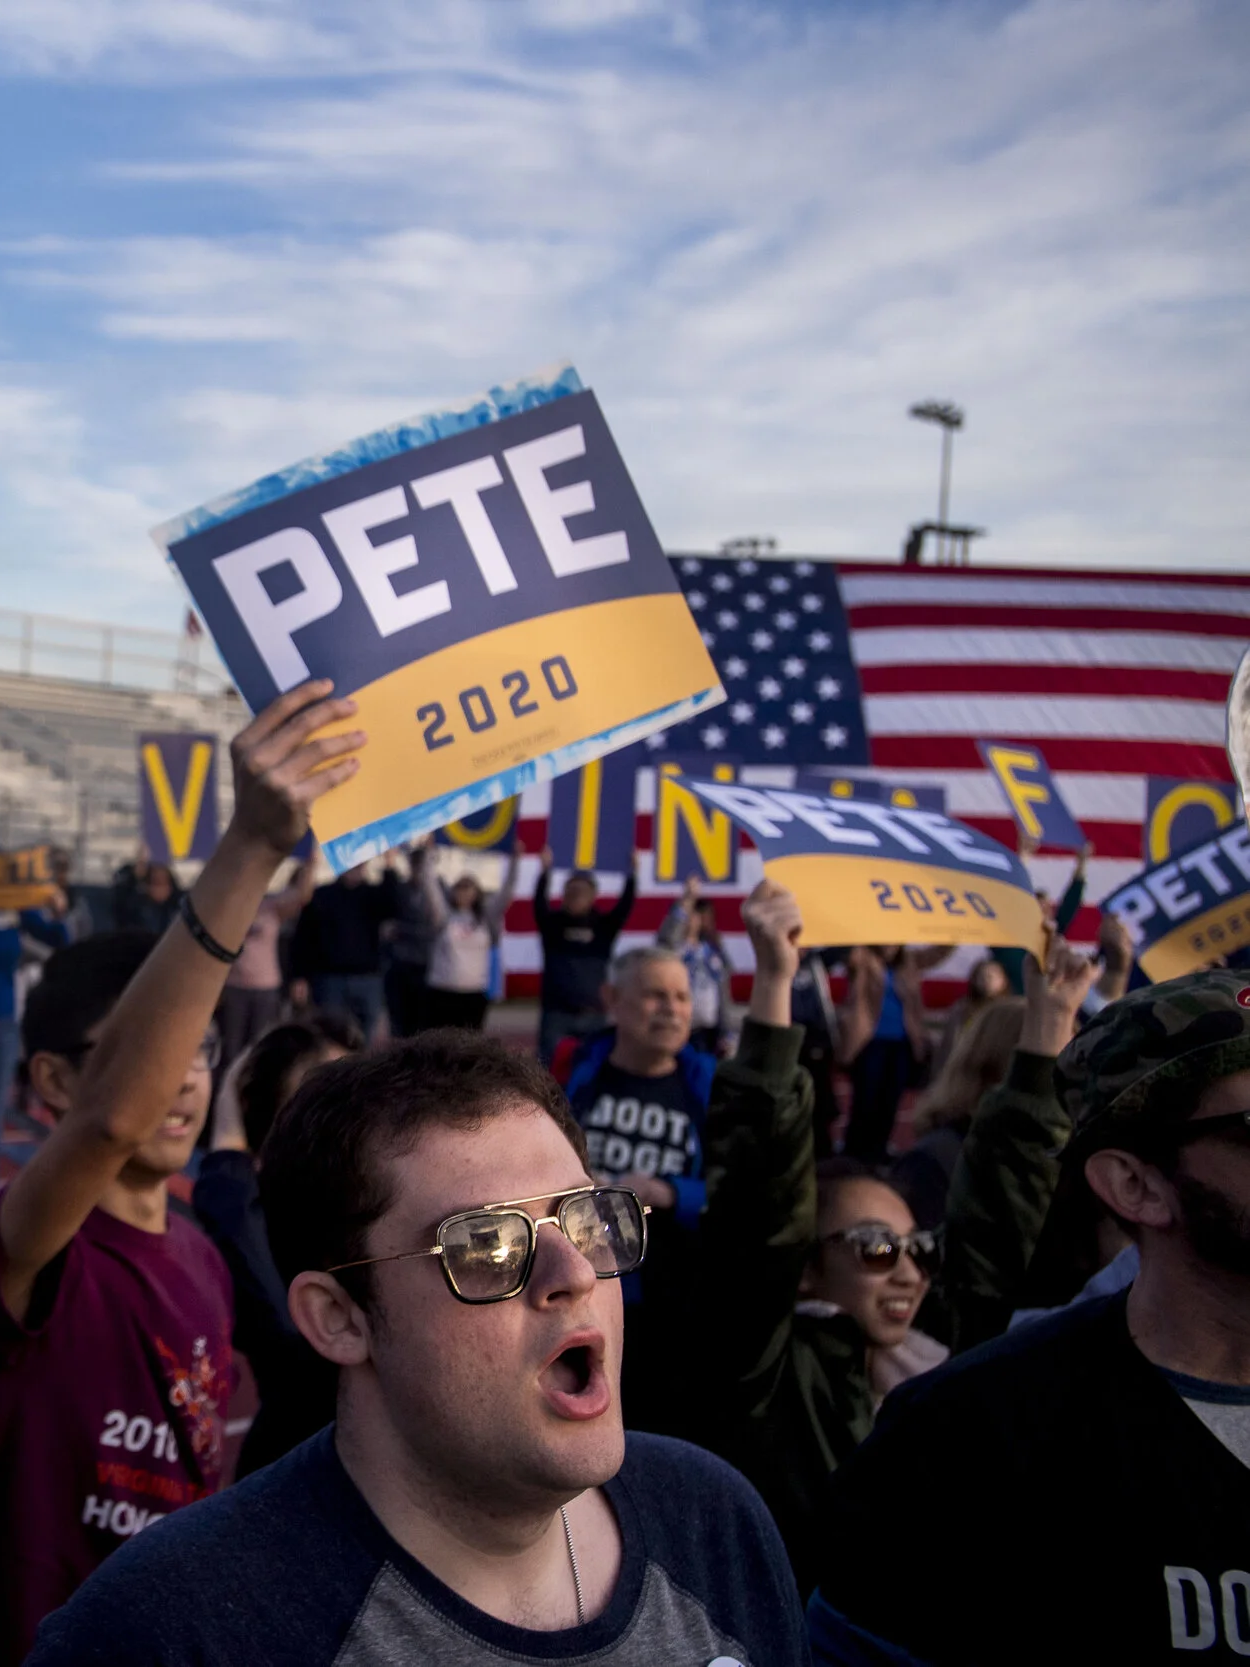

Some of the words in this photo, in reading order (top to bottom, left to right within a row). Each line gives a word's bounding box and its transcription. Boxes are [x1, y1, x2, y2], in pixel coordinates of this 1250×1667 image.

[211, 423, 631, 694] PETE
[416, 655, 579, 752] 2020
[691, 781, 1013, 872] PETE
[870, 879, 998, 920] 2020
